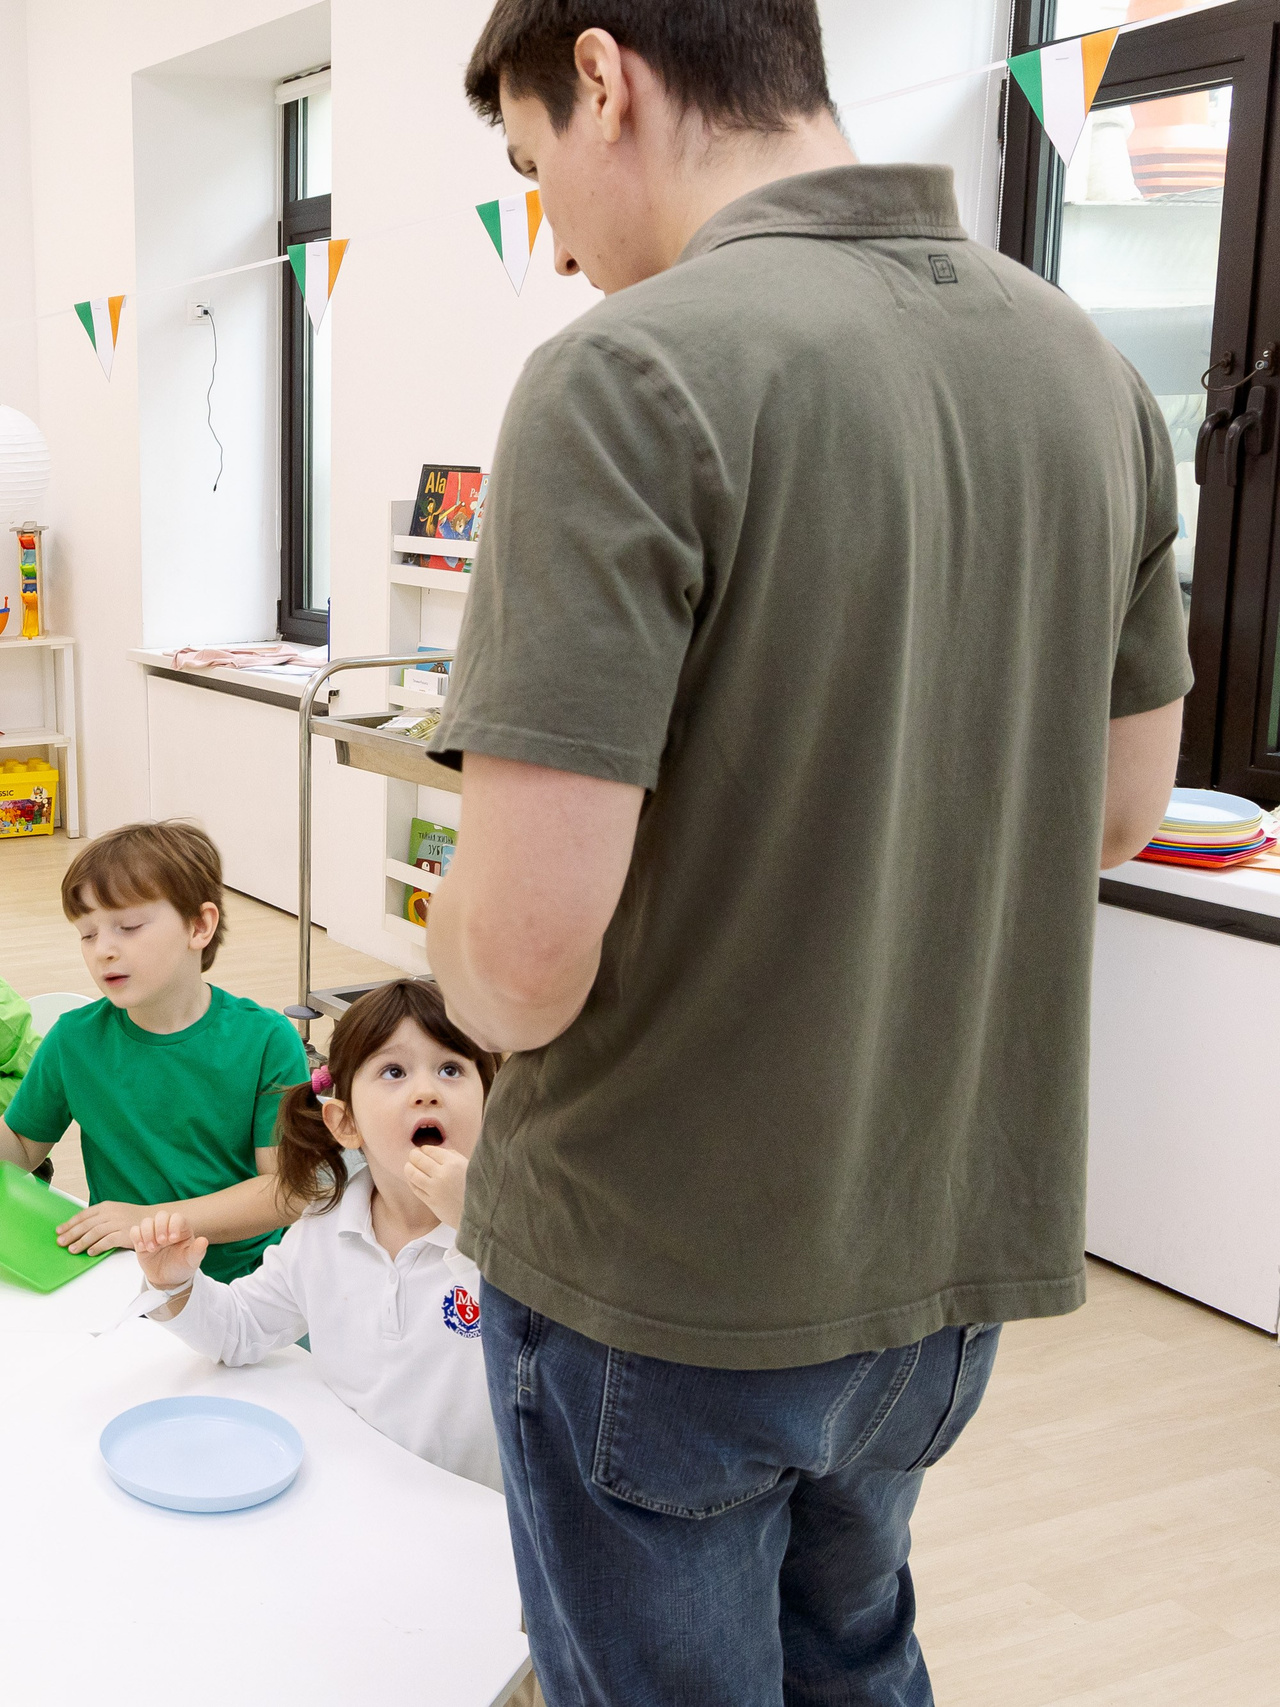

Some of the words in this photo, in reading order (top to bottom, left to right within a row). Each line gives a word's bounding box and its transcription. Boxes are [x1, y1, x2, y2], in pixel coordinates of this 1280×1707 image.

[425, 472, 446, 493] Ala
[429, 844, 443, 855] ЗУБ
[465, 1306, 473, 1320] S
